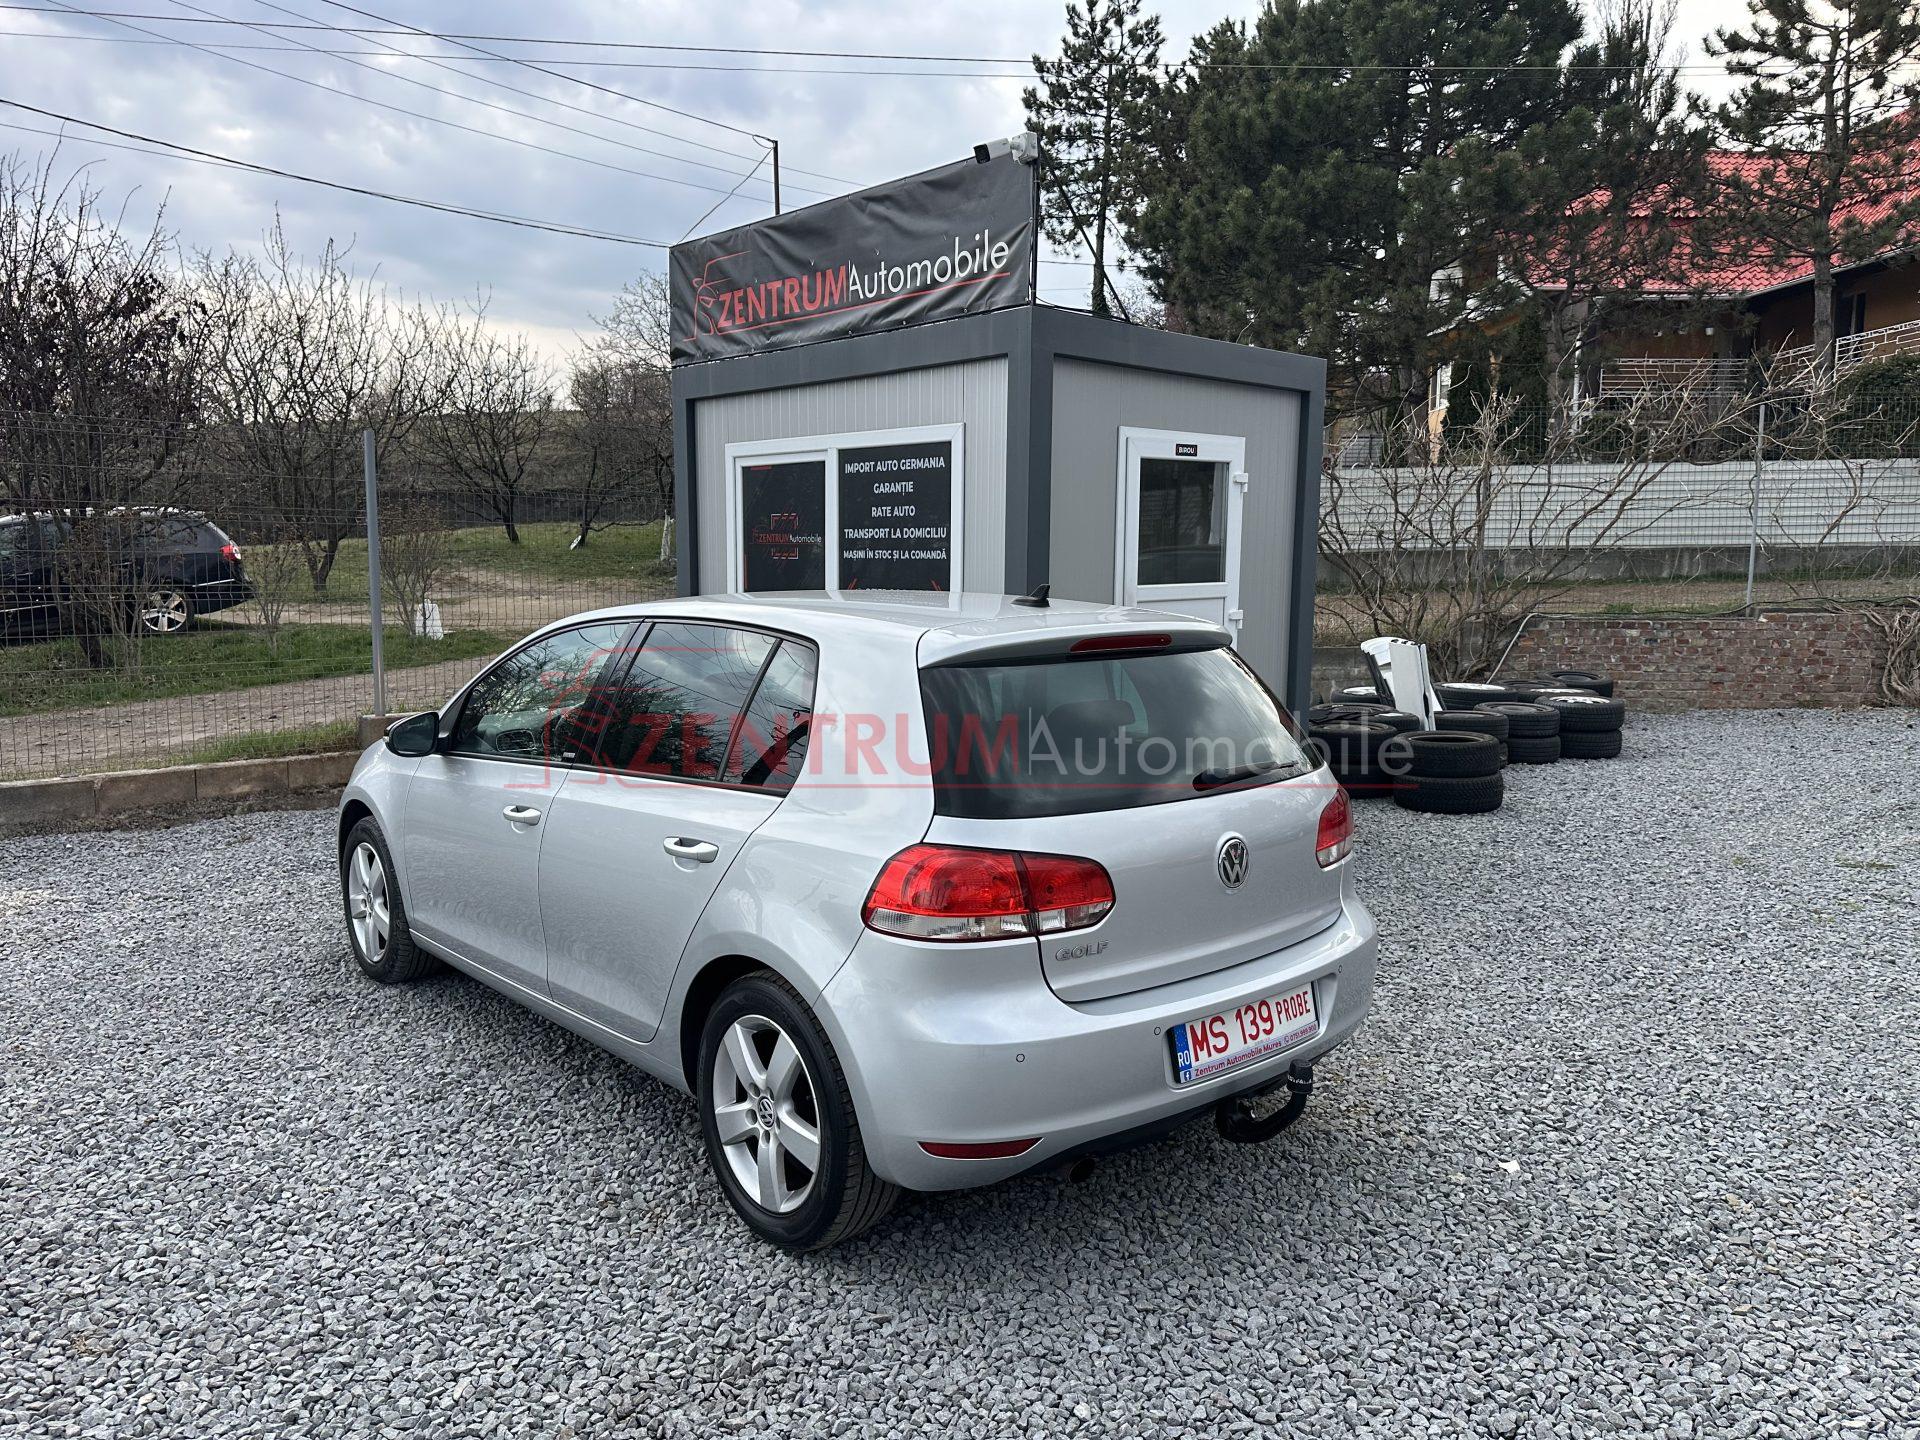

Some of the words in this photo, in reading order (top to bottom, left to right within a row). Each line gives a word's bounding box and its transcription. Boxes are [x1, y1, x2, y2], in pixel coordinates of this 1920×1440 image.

[717, 265, 847, 329] ZENTRUM
[850, 229, 1009, 300] Automobile
[1178, 446, 1195, 454] BIROU
[845, 461, 875, 474] IMPORT
[876, 460, 898, 472] AUTO
[900, 456, 945, 470] GERMANIA
[873, 481, 914, 496] GARANȚIE
[871, 506, 891, 517] RATE
[893, 505, 916, 517] AUTO
[844, 528, 889, 539] TRANSPORT
[891, 528, 901, 539] LA
[903, 527, 947, 539] DOMICILIU
[843, 550, 865, 561] MAȘINI
[866, 548, 874, 559] ÎN
[875, 550, 892, 559] STOC
[900, 550, 910, 559] LA
[911, 548, 947, 560] COMANDĂ
[1055, 940, 1109, 962] GOLF
[1190, 1015, 1229, 1062] MS
[1235, 1000, 1275, 1044] 139
[1276, 990, 1311, 1025] PROBE
[1177, 1050, 1191, 1068] RO
[1194, 1061, 1226, 1077] Zentrum
[1227, 1048, 1262, 1066] Automobile
